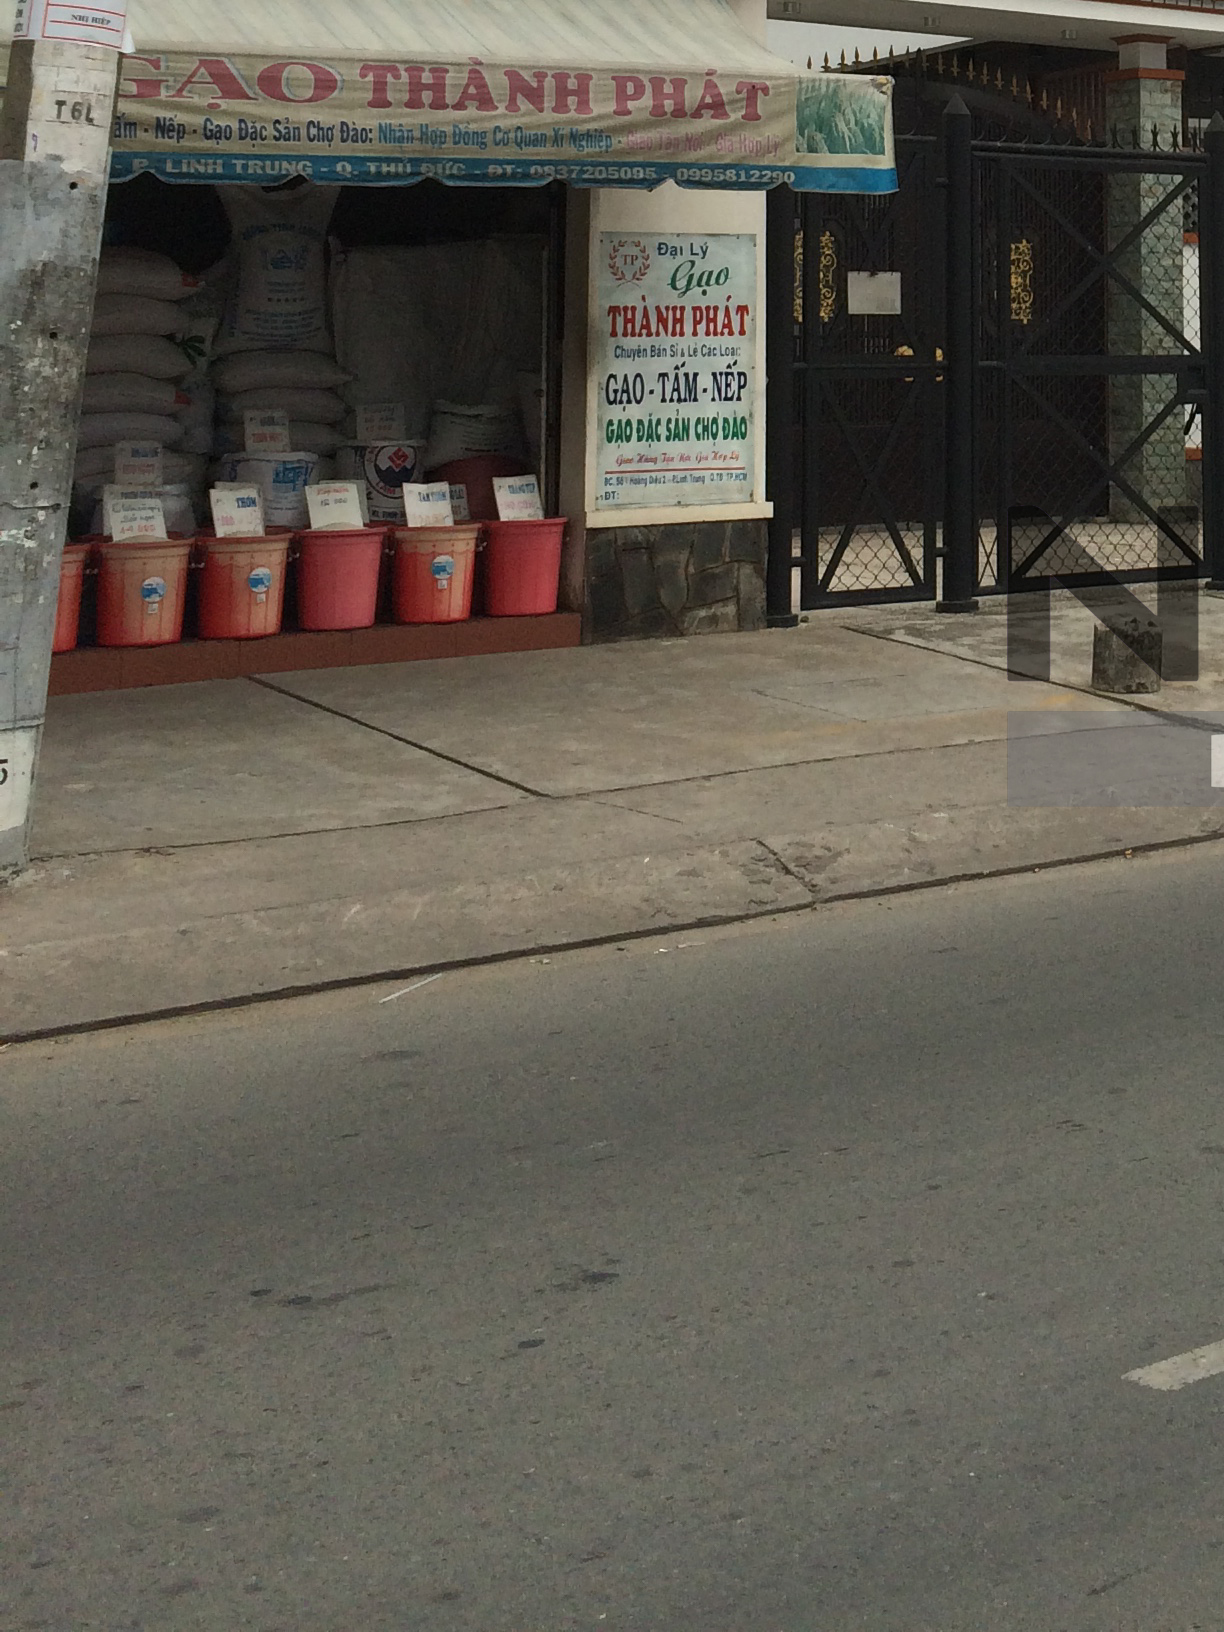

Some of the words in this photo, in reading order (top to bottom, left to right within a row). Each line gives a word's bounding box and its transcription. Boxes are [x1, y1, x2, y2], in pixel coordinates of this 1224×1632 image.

[359, 56, 593, 115] THÀNH
[611, 69, 770, 121] PHÁT
[113, 113, 138, 139] ấm
[155, 114, 186, 143] Nếp
[203, 117, 232, 145] Gạo
[238, 118, 267, 148] Đặc
[273, 116, 301, 142] Sản
[307, 120, 335, 148] Chợ
[340, 121, 373, 145] Đào:
[452, 122, 487, 150] Đồng
[515, 126, 548, 149] Quan
[166, 159, 223, 173] LINH
[232, 160, 312, 175] TRUNG
[621, 254, 639, 266] TP
[657, 242, 683, 259] Đại
[690, 242, 709, 259] Lý
[667, 260, 730, 298] Gạo
[608, 295, 686, 337] THÀNH
[691, 295, 750, 337] PHÁT
[614, 344, 648, 361] Chuyên
[650, 344, 667, 358] Bán
[605, 373, 645, 412] GẠO
[657, 361, 699, 404] TẤM
[711, 360, 747, 402] NẾP
[606, 418, 633, 449] GẠO
[636, 413, 661, 448] ĐẶC
[665, 409, 690, 442] SẢN
[694, 411, 719, 446] CHỢ
[722, 410, 748, 441] ĐÀO
